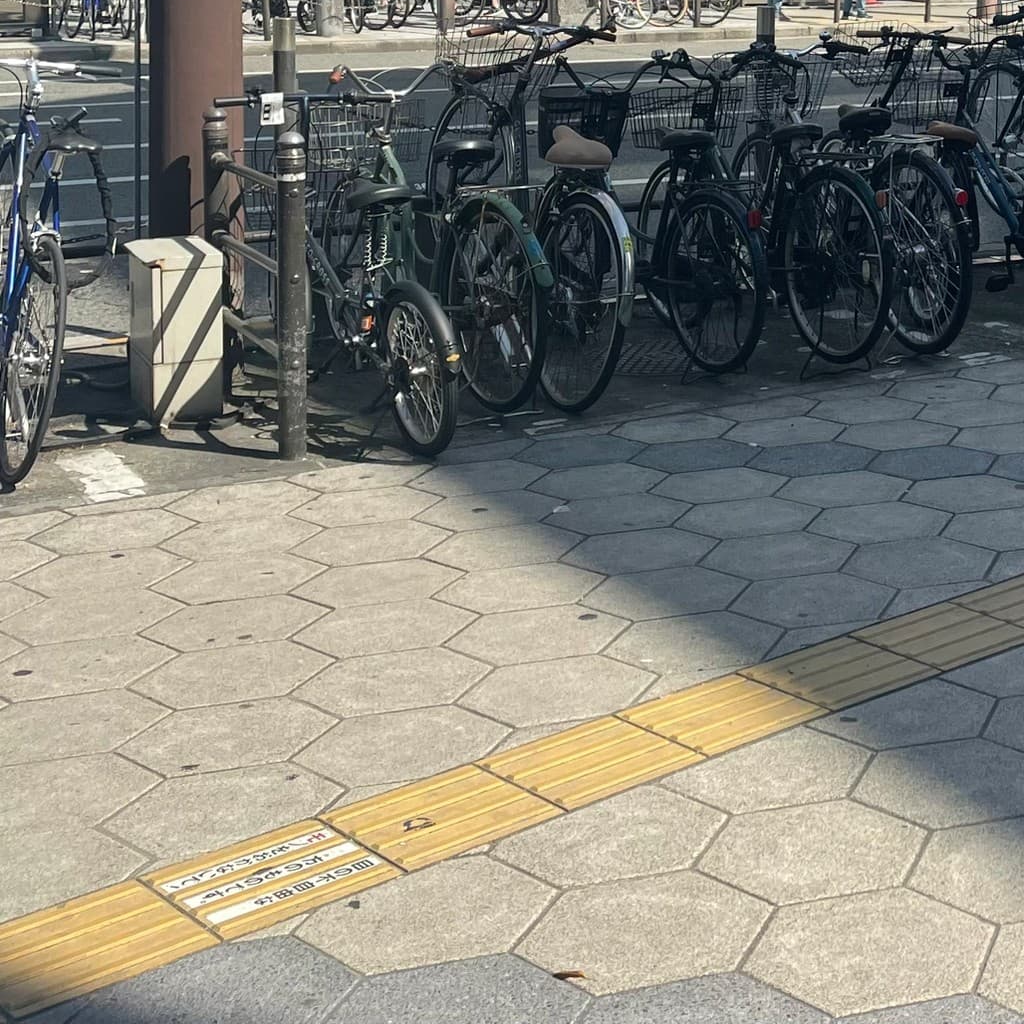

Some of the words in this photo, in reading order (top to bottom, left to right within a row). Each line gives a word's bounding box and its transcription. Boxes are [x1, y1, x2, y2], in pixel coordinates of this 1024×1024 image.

[252, 856, 375, 907] 目の不自由な
